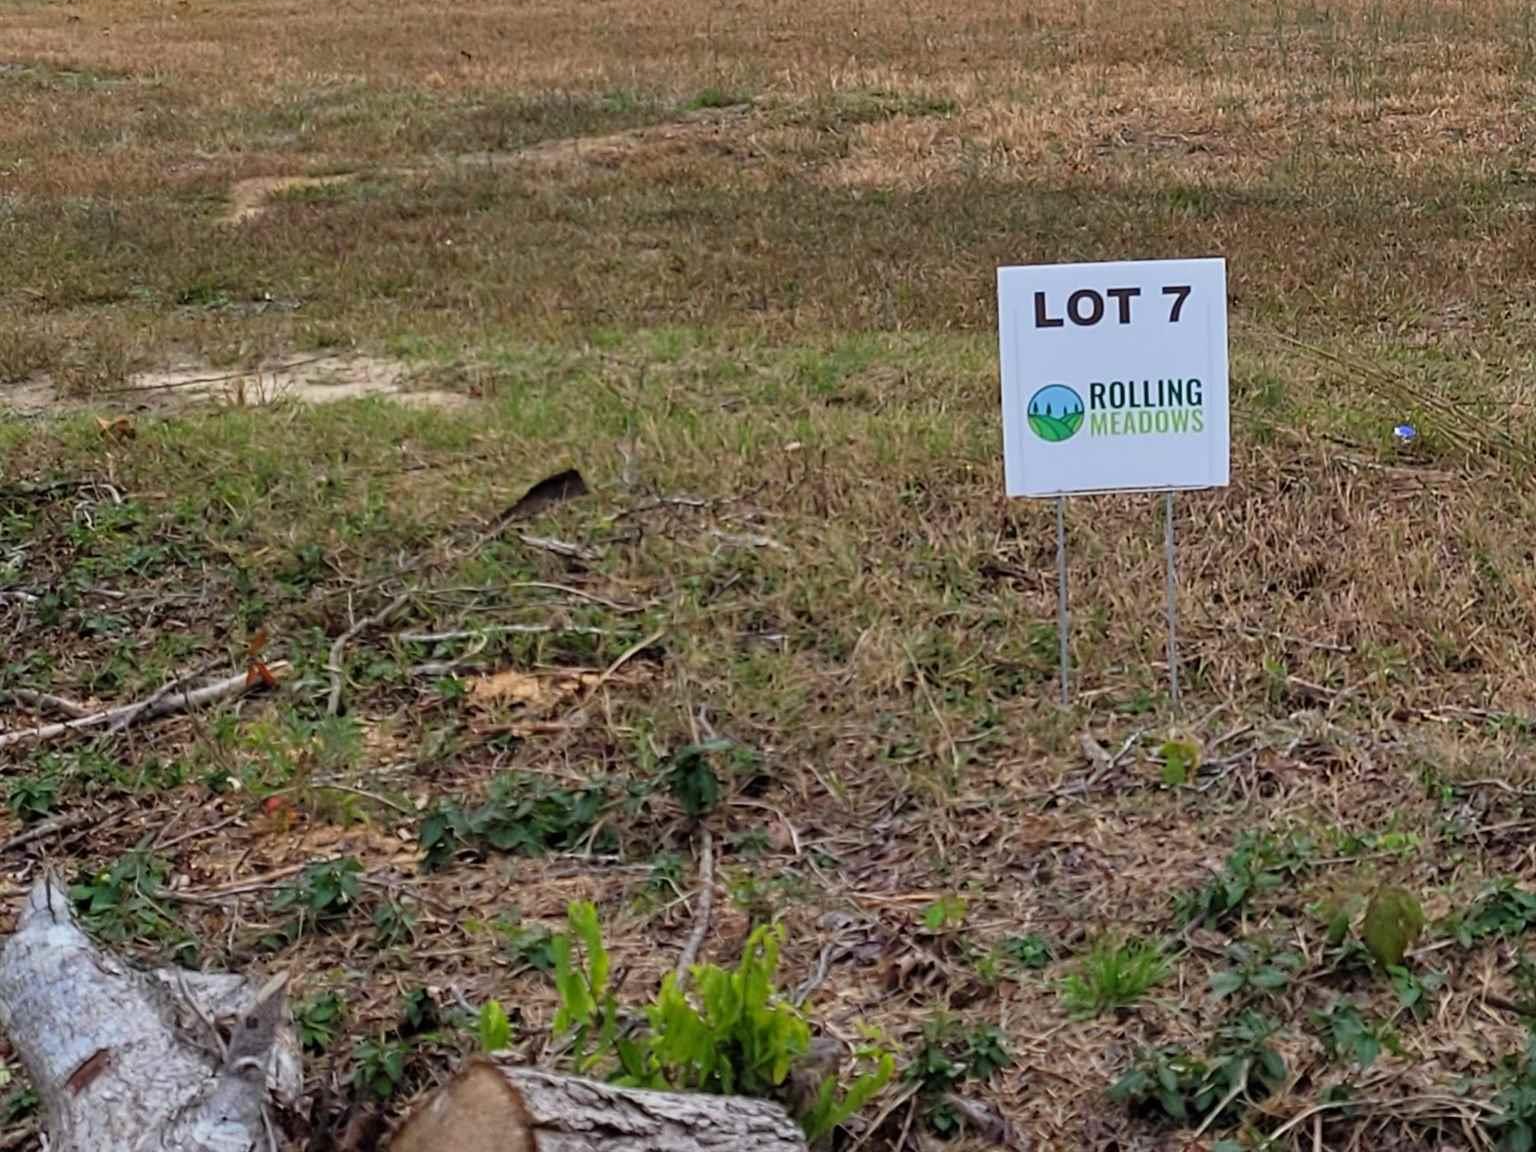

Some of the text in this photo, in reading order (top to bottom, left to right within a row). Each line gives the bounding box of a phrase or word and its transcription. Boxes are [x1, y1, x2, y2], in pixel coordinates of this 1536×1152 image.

[1033, 285, 1192, 328] LOT 7
[1089, 378, 1203, 410] ROLLING
[1090, 409, 1204, 436] MEADOWS
